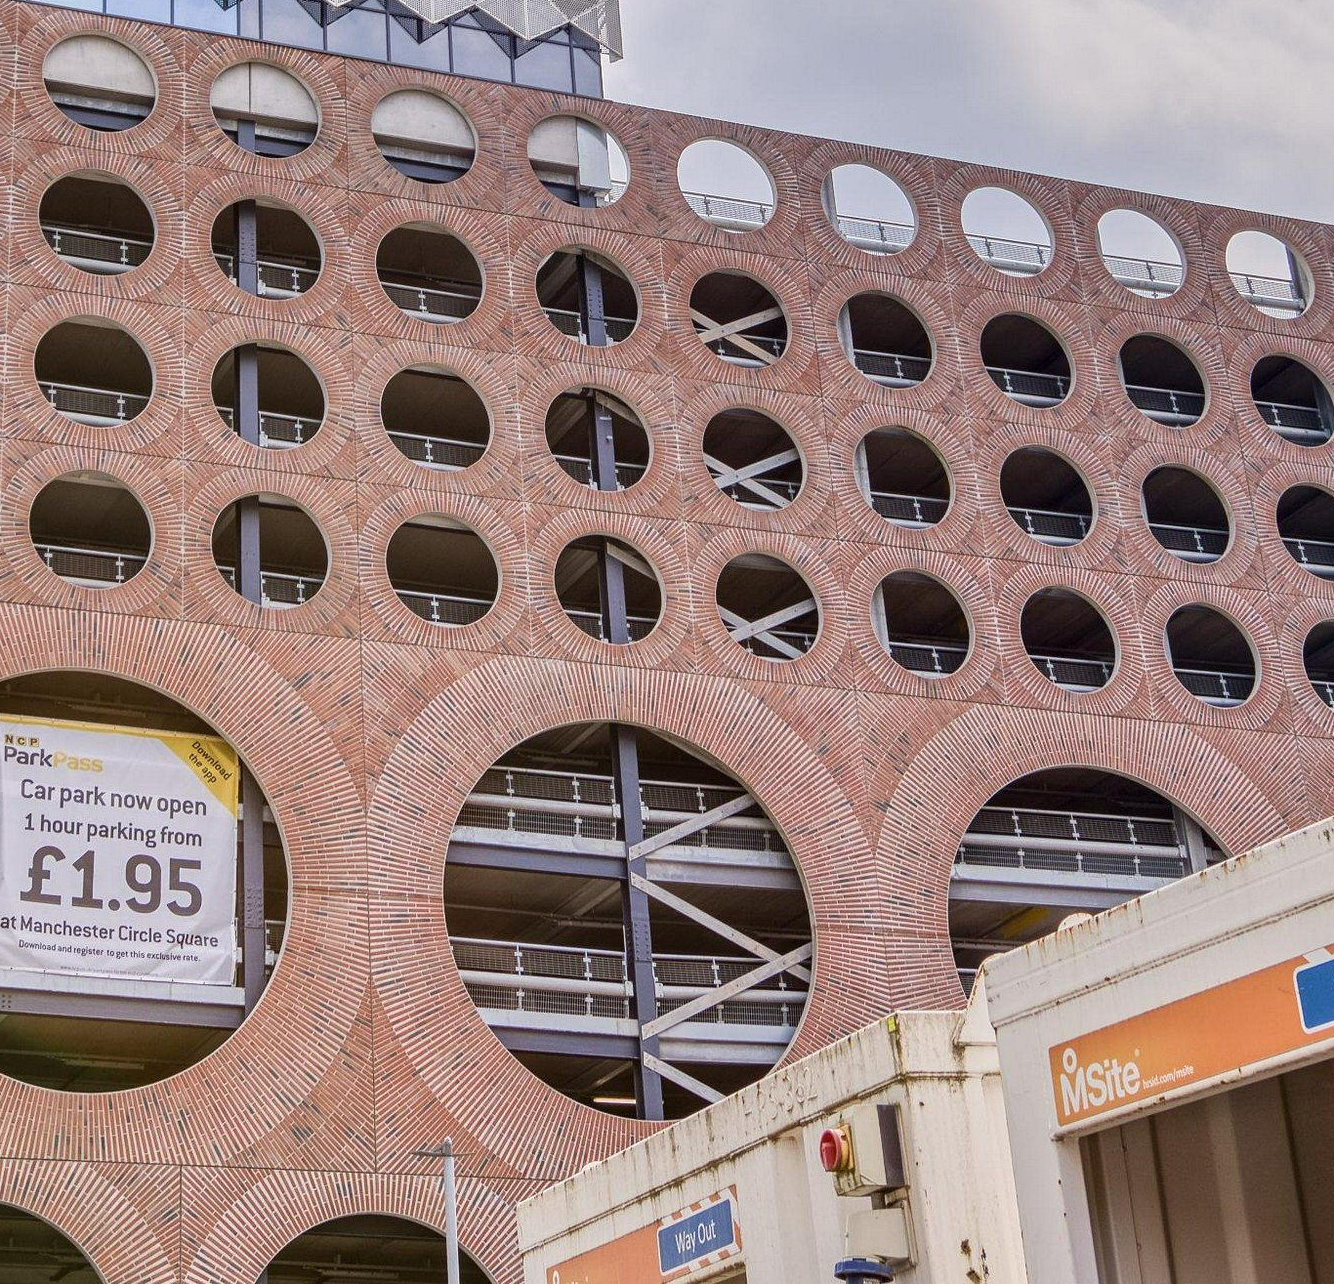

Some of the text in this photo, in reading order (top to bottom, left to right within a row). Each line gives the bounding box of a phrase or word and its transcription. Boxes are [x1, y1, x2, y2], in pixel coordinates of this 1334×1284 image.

[4, 734, 39, 747] NCP
[4, 745, 103, 773] ParkPass
[188, 753, 217, 784] the app
[191, 741, 232, 781] Download
[20, 779, 207, 819] Car park now open
[24, 813, 202, 848] 1 hour parking from
[20, 845, 203, 917] £1.95
[0, 915, 218, 948] at Manchester Circle Square
[18, 939, 201, 963] Download and register to get this exclusive rate.
[1142, 1064, 1195, 1090] hrsid.com/msite
[675, 1219, 717, 1254] Way Out
